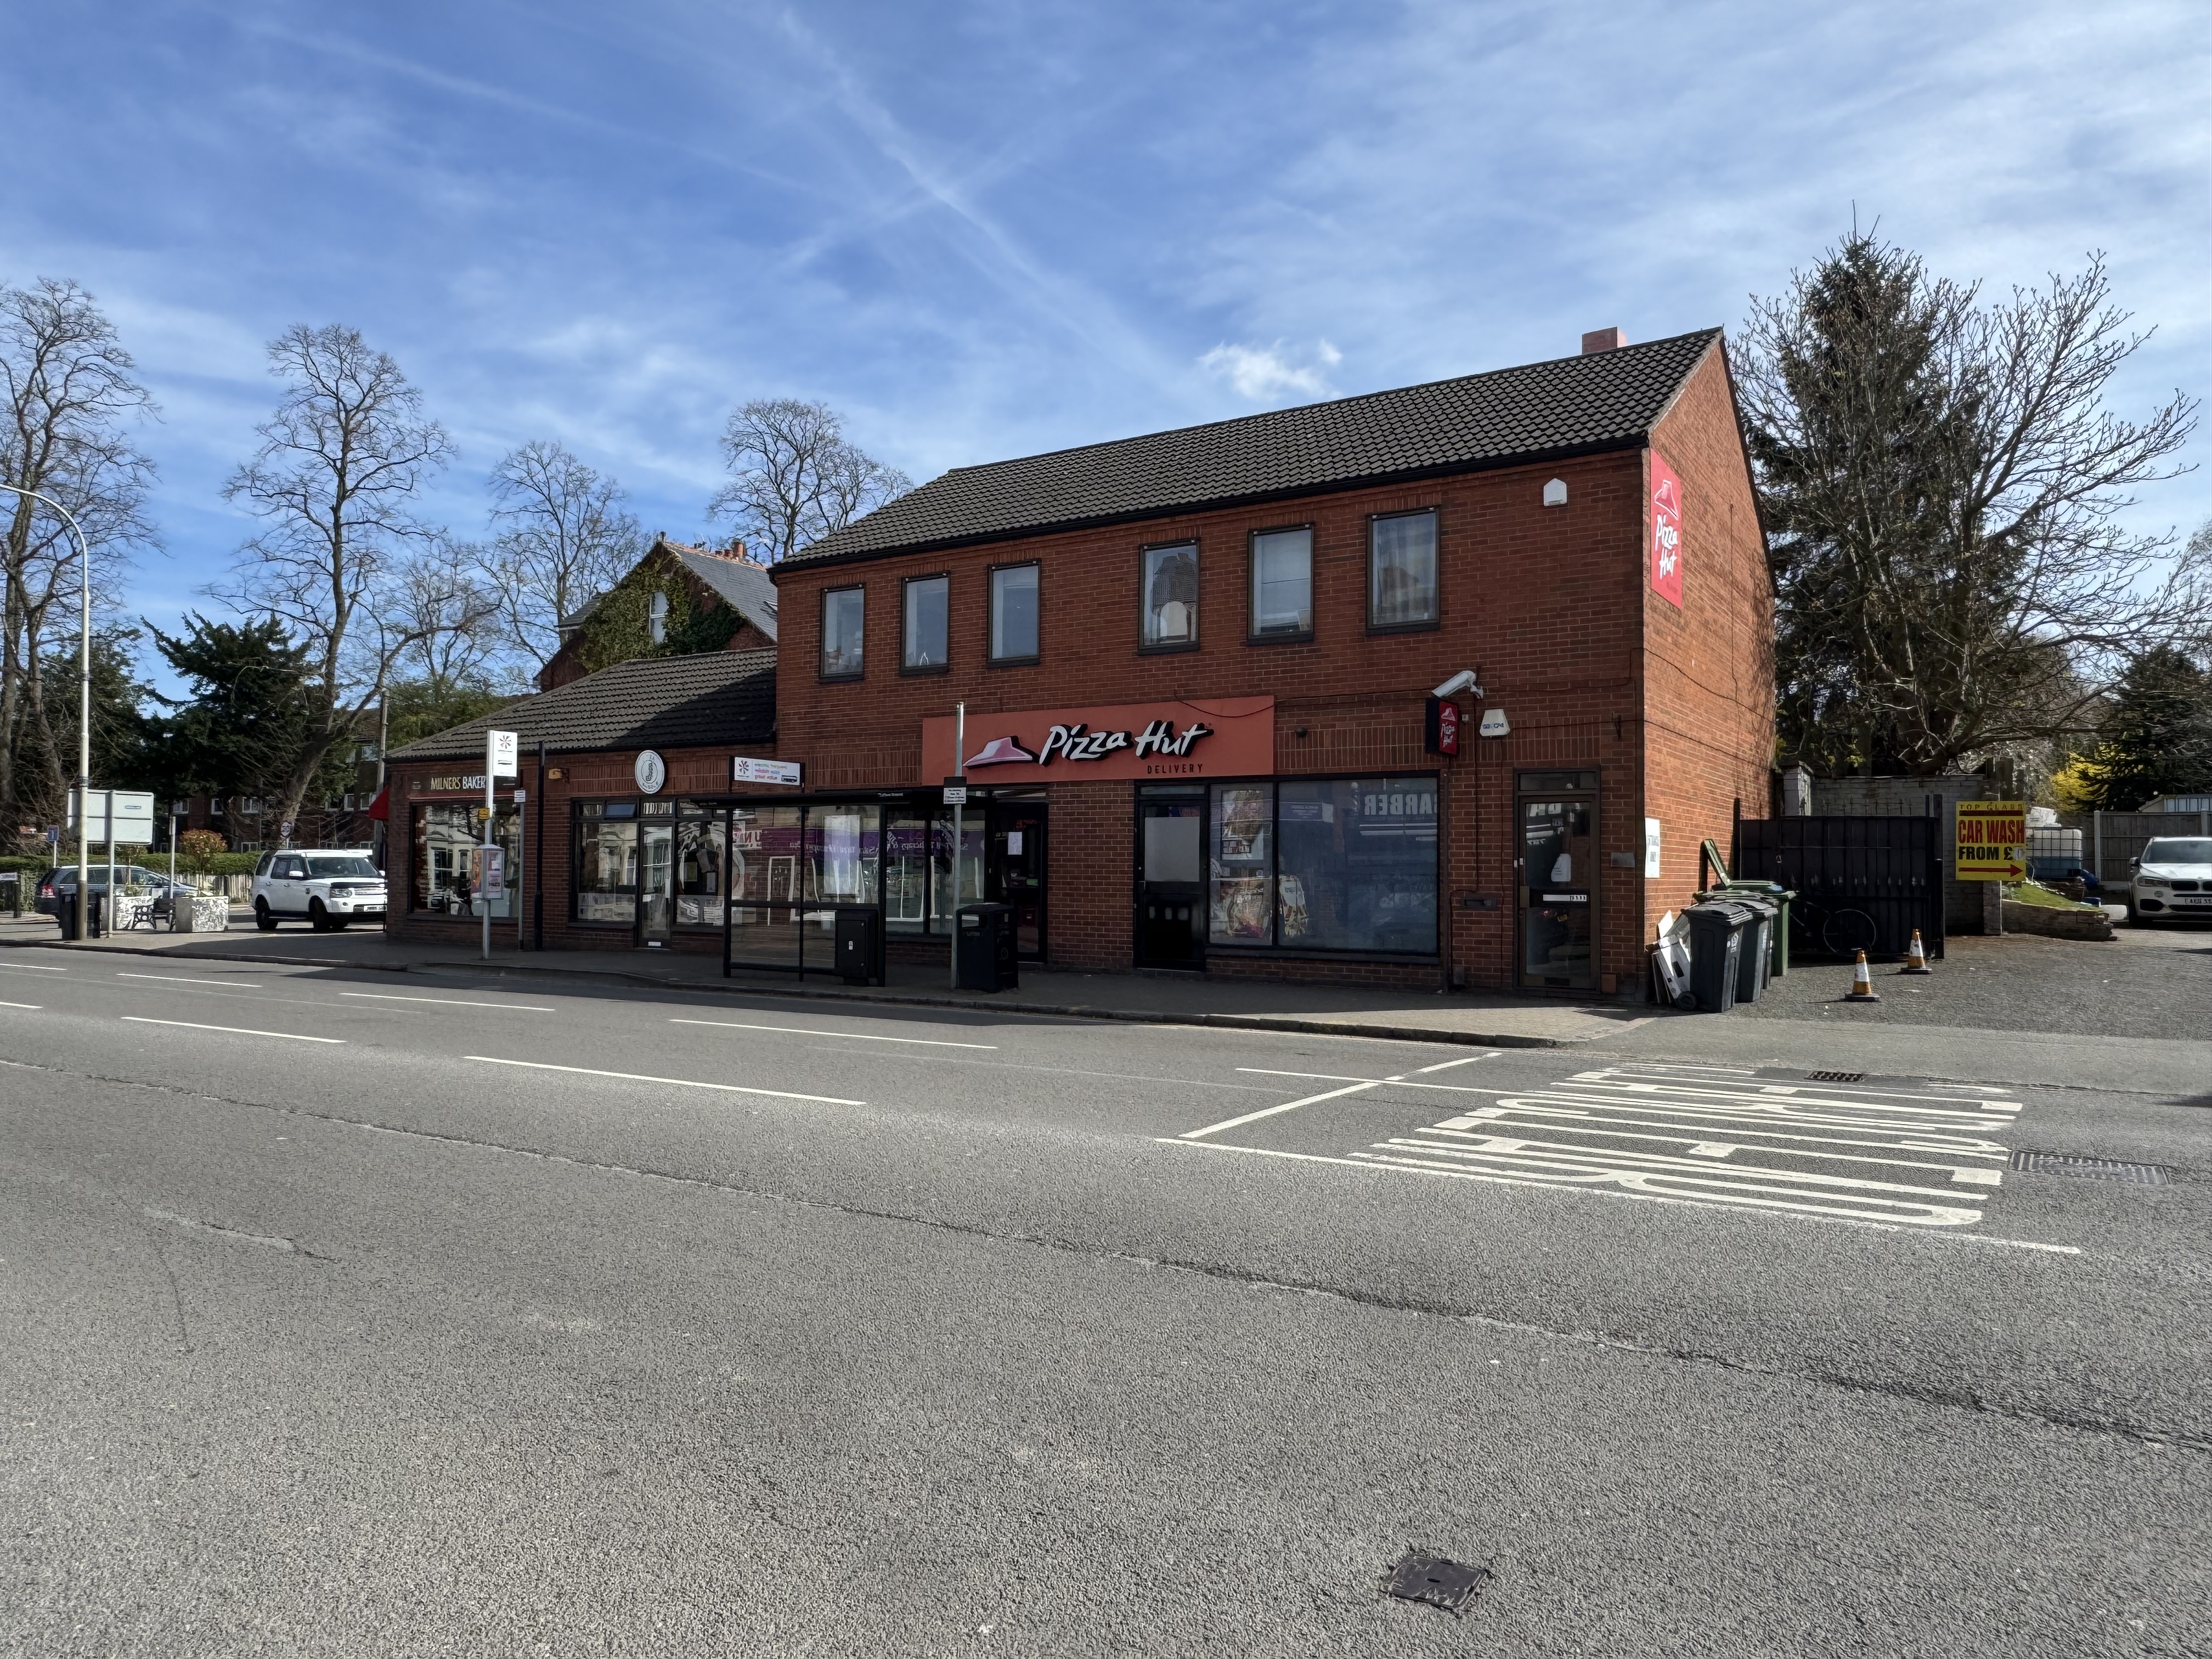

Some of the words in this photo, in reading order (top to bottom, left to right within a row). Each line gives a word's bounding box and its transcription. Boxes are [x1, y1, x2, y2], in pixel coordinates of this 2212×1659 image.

[1655, 514, 1678, 552] Pizza
[1659, 548, 1677, 580] Hut
[1039, 724, 1128, 765] Pizza
[1135, 720, 1209, 757] Hut
[1147, 764, 1203, 774] DELIVERY
[431, 776, 461, 791] MILNERS
[462, 775, 487, 789] BAKER
[1958, 820, 1983, 843] CAR
[1987, 820, 2024, 844] WASH
[1959, 846, 1999, 860] FROM
